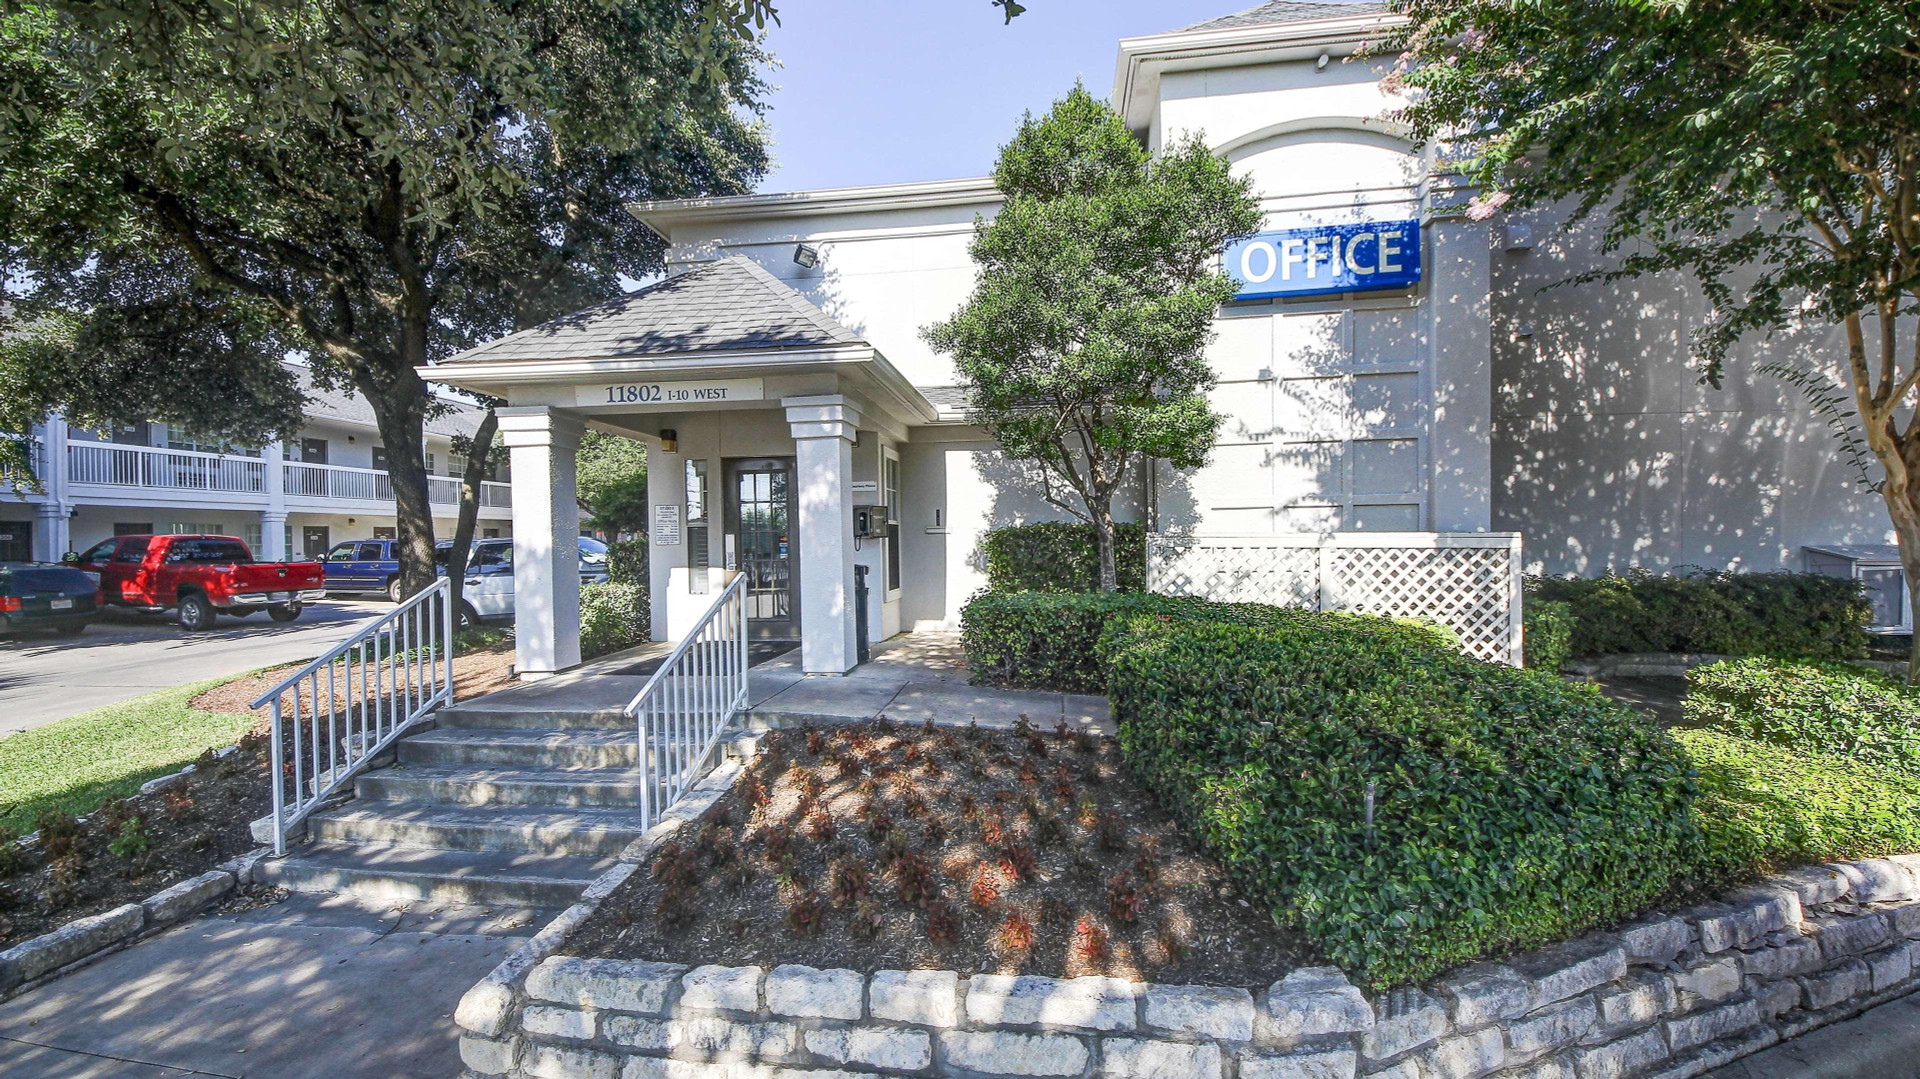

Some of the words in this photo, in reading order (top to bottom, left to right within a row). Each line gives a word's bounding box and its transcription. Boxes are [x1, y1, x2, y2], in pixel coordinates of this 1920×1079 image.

[1240, 230, 1403, 284] OFFICE
[606, 385, 662, 403] 11802
[668, 389, 689, 401] I-10
[694, 388, 728, 400] WEST
